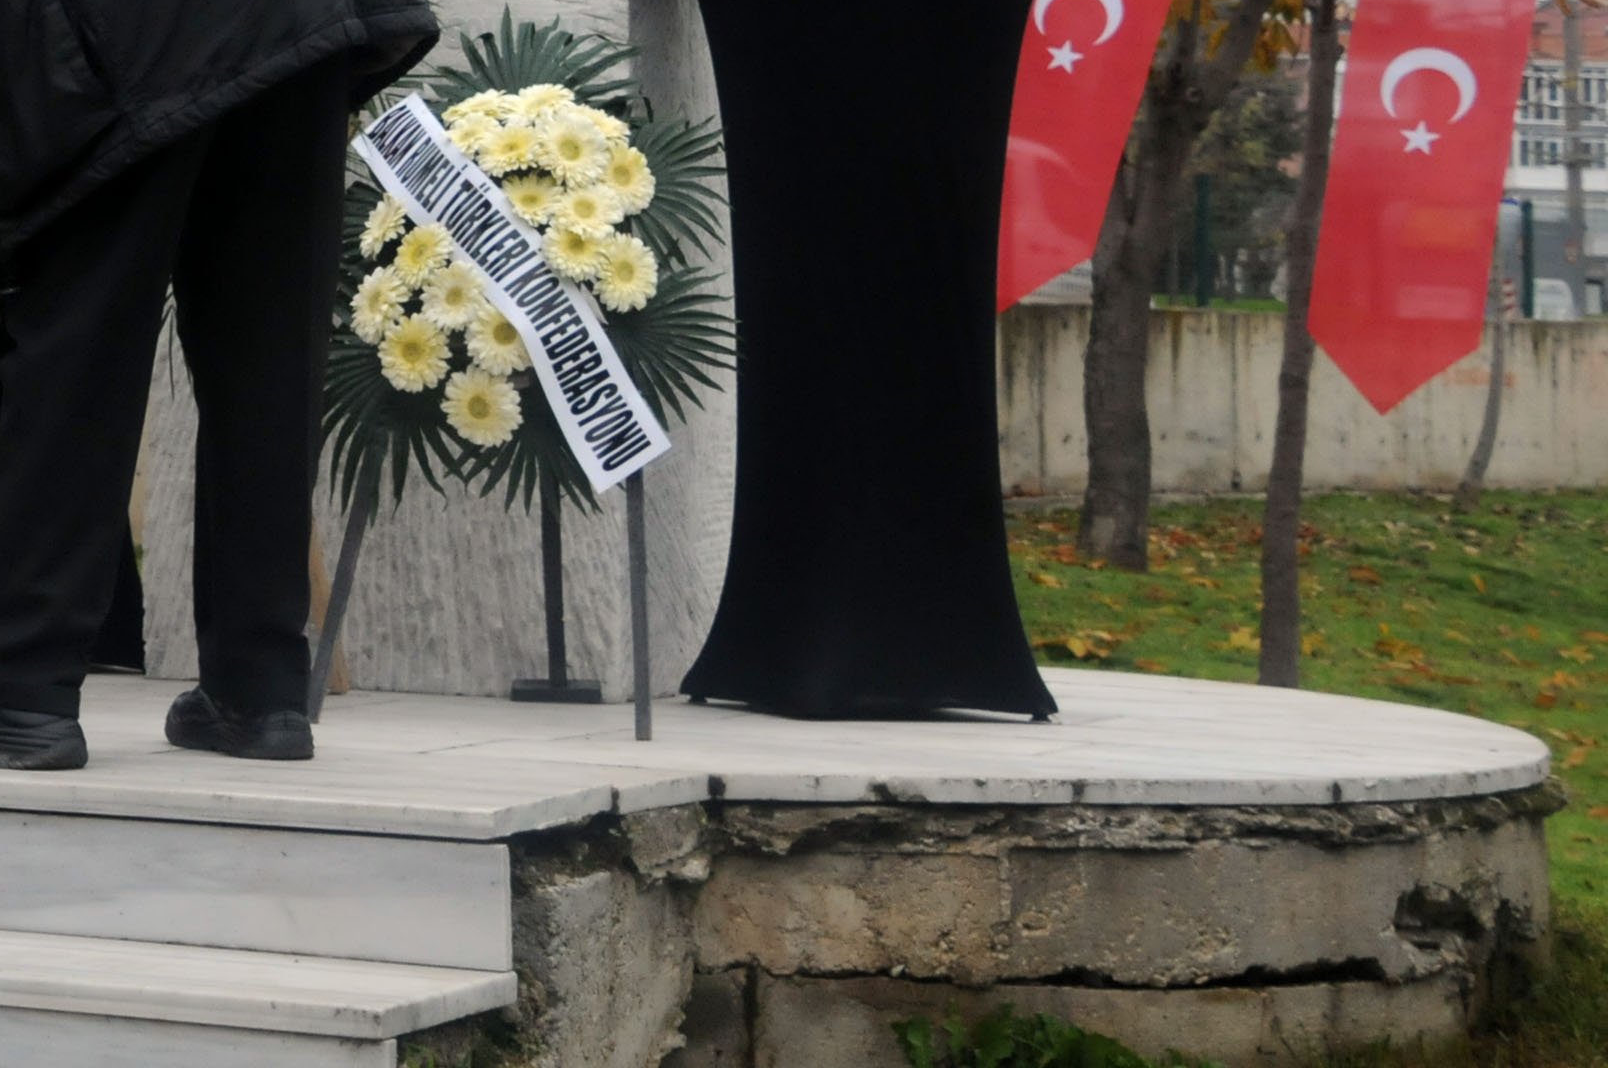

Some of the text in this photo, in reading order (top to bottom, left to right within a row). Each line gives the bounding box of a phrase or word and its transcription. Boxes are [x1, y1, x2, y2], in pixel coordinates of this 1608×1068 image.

[364, 101, 651, 473] BALKAN RUMELİ TÜRKLERİ KONFEDERASYONU
